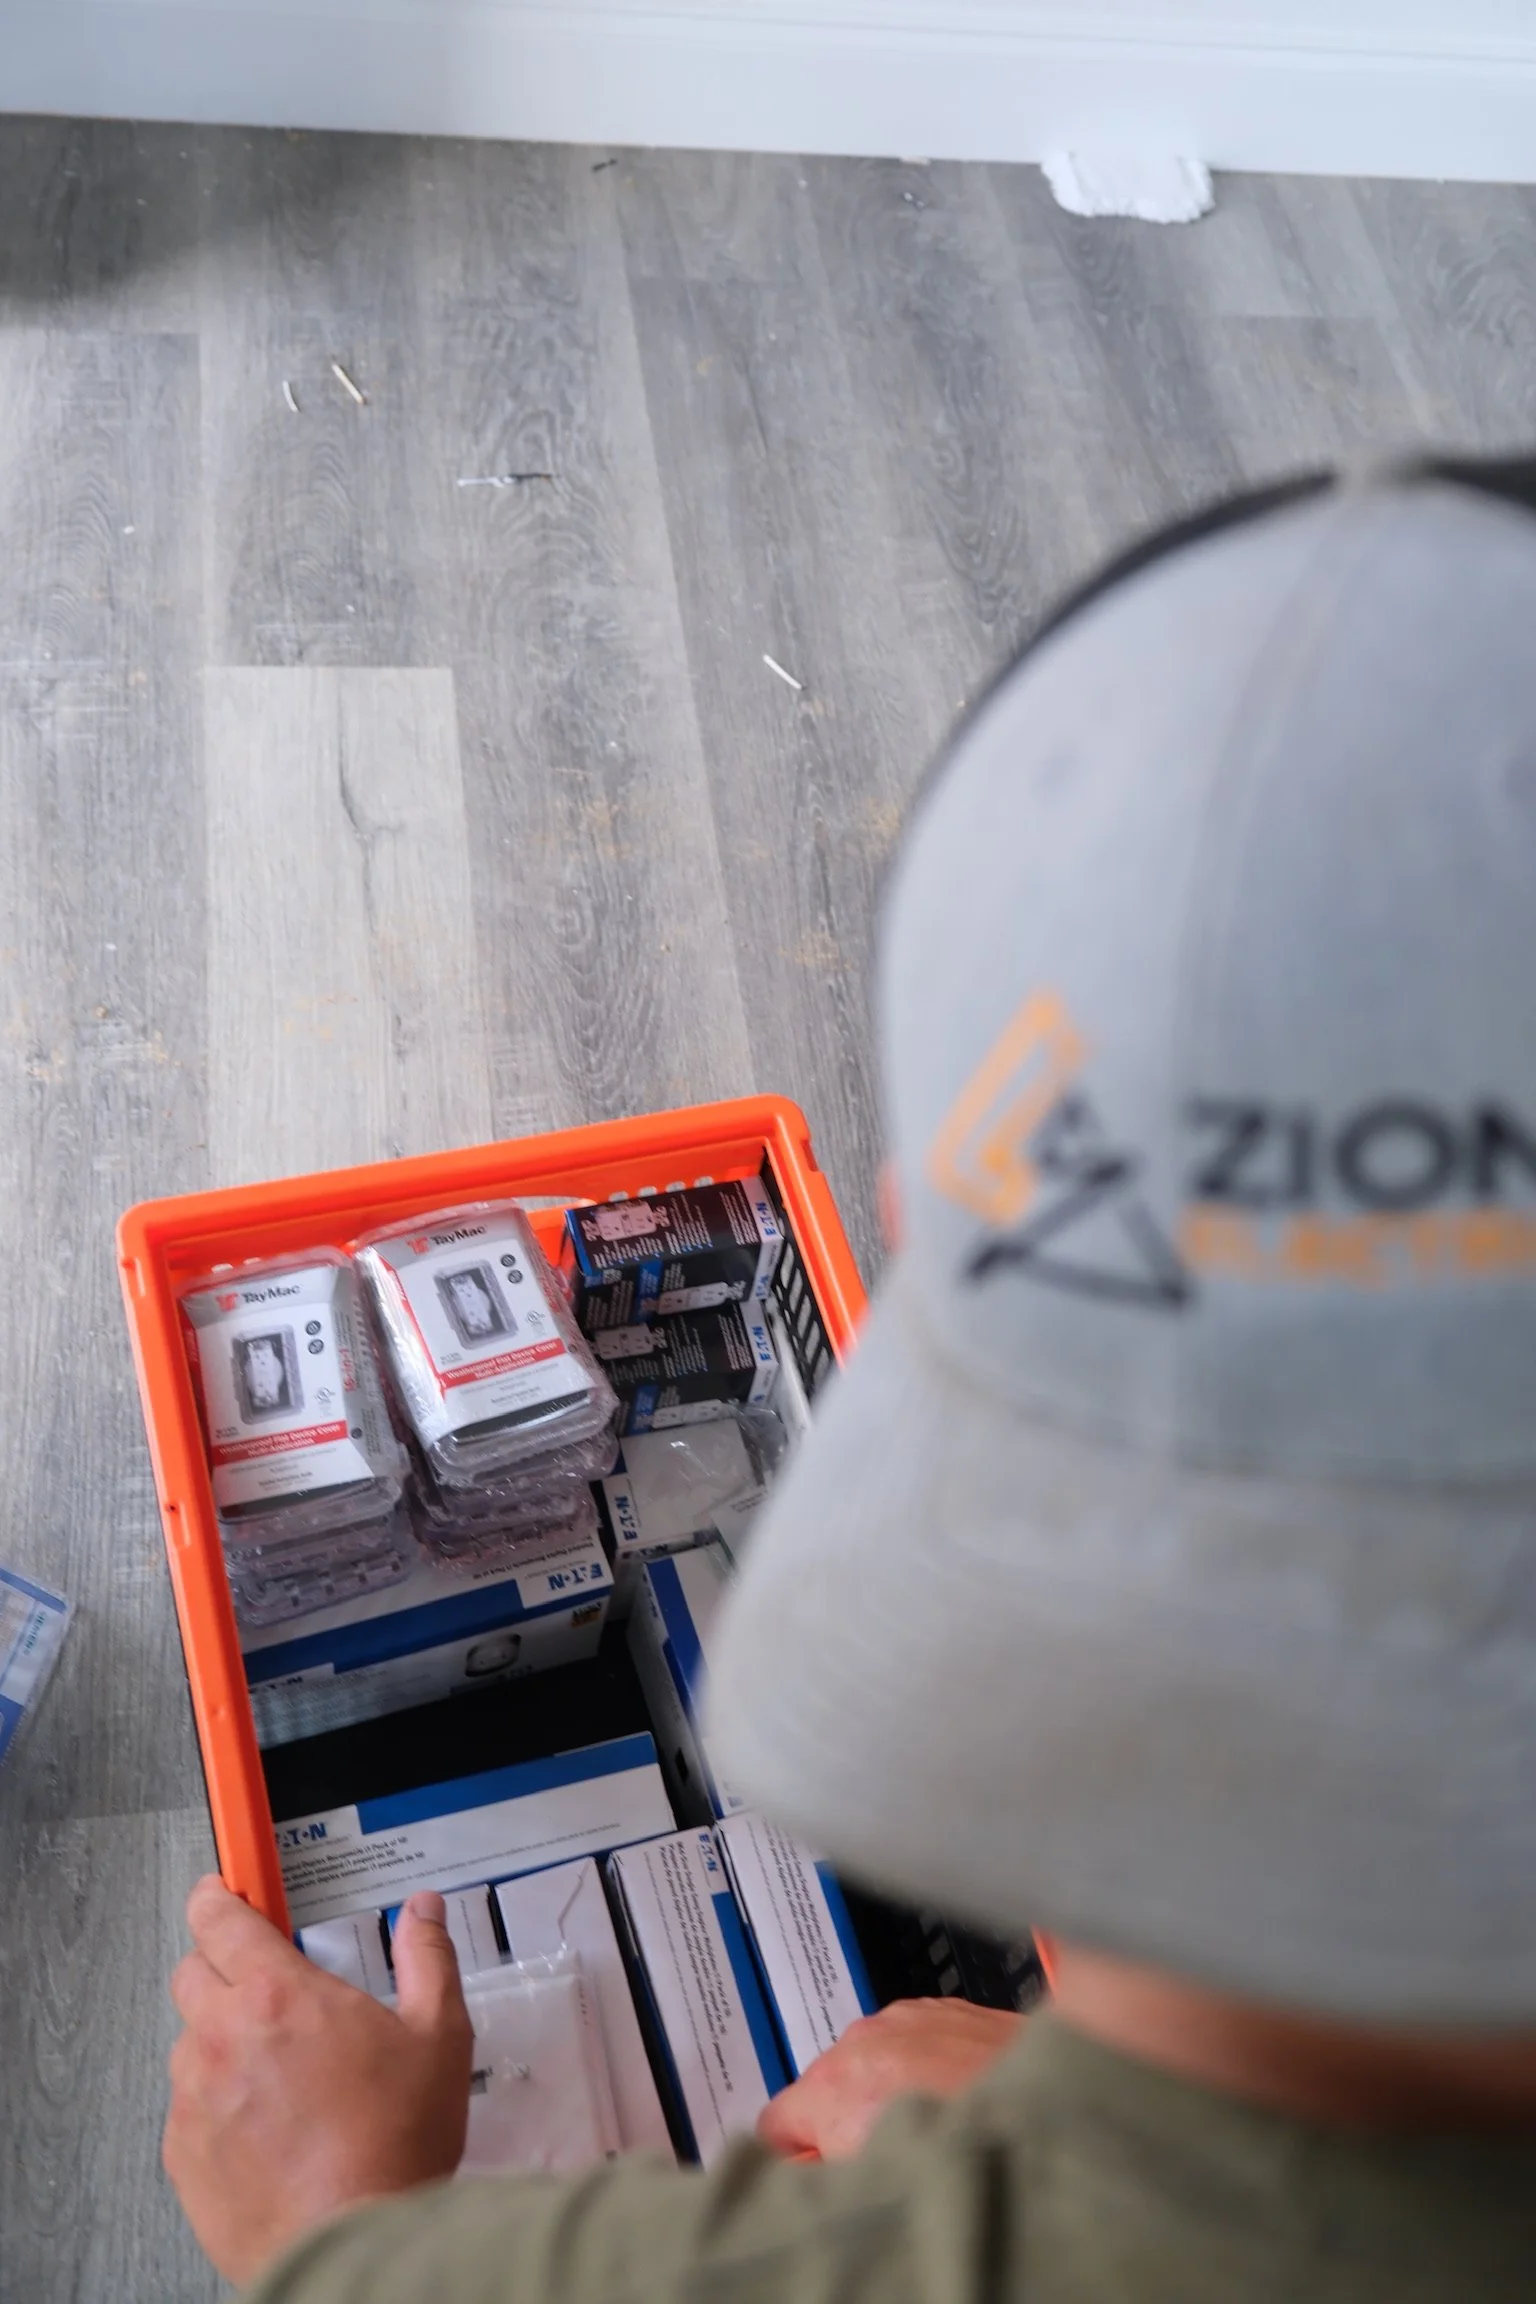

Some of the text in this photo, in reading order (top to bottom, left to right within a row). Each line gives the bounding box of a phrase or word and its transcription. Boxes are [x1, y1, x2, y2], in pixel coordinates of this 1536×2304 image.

[1186, 1097, 1536, 1208] ZION
[430, 1225, 487, 1248] TayMac
[242, 1285, 300, 1303] TayMac
